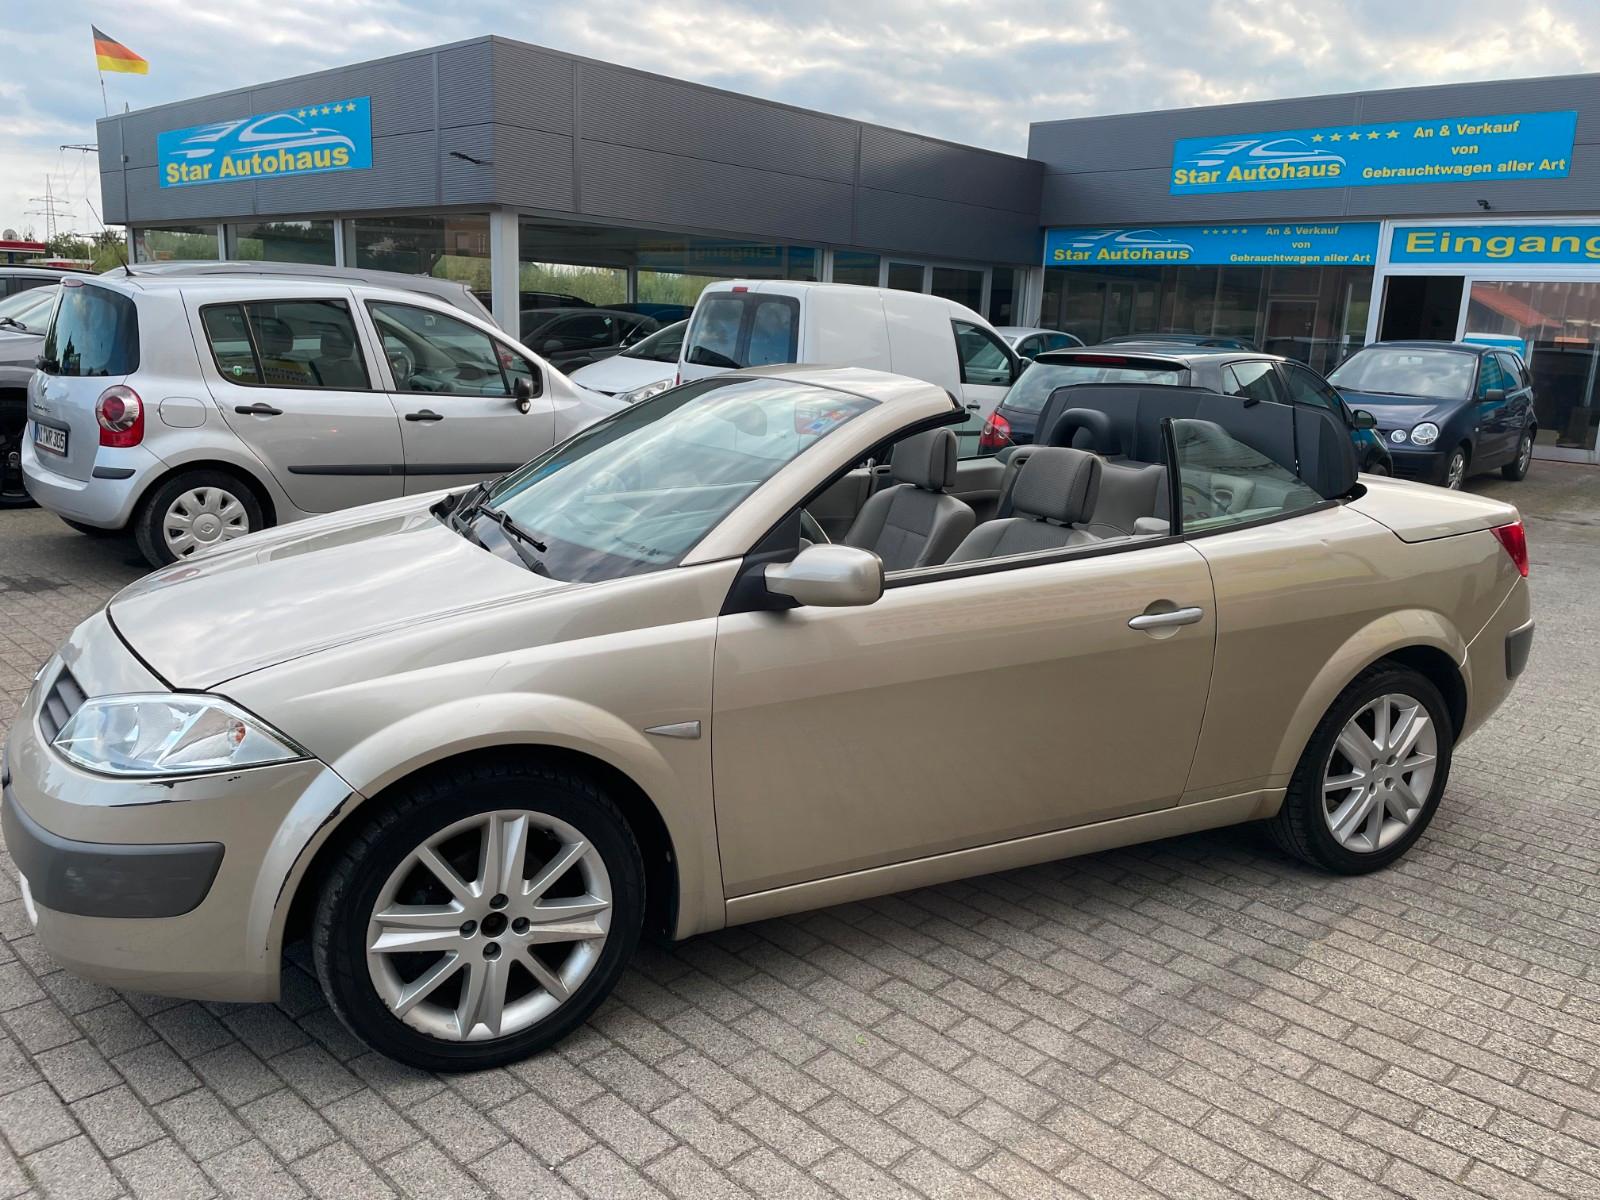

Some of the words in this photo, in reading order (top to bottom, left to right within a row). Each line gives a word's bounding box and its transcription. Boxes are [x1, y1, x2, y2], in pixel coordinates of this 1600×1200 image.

[1413, 126, 1434, 139] An
[1439, 125, 1451, 137] &
[1456, 120, 1521, 135] Verkauf
[1451, 144, 1479, 155] von
[166, 161, 213, 184] Star
[219, 146, 349, 178] Autohaus
[1362, 162, 1493, 179] Gebrauchtwagen
[1497, 159, 1535, 173] aller
[1538, 158, 1566, 171] Art
[1174, 168, 1221, 185] Star
[1226, 162, 1341, 182] Autohaus
[1265, 227, 1280, 235] An
[1283, 226, 1291, 235] &
[1295, 225, 1340, 235] Verkauf
[1292, 241, 1311, 249] von
[1053, 248, 1092, 261] Star
[1097, 247, 1190, 260] Autohaus
[1230, 253, 1320, 264] Gebrauchtwagen
[1323, 253, 1349, 262] aller
[1352, 253, 1371, 262] Art
